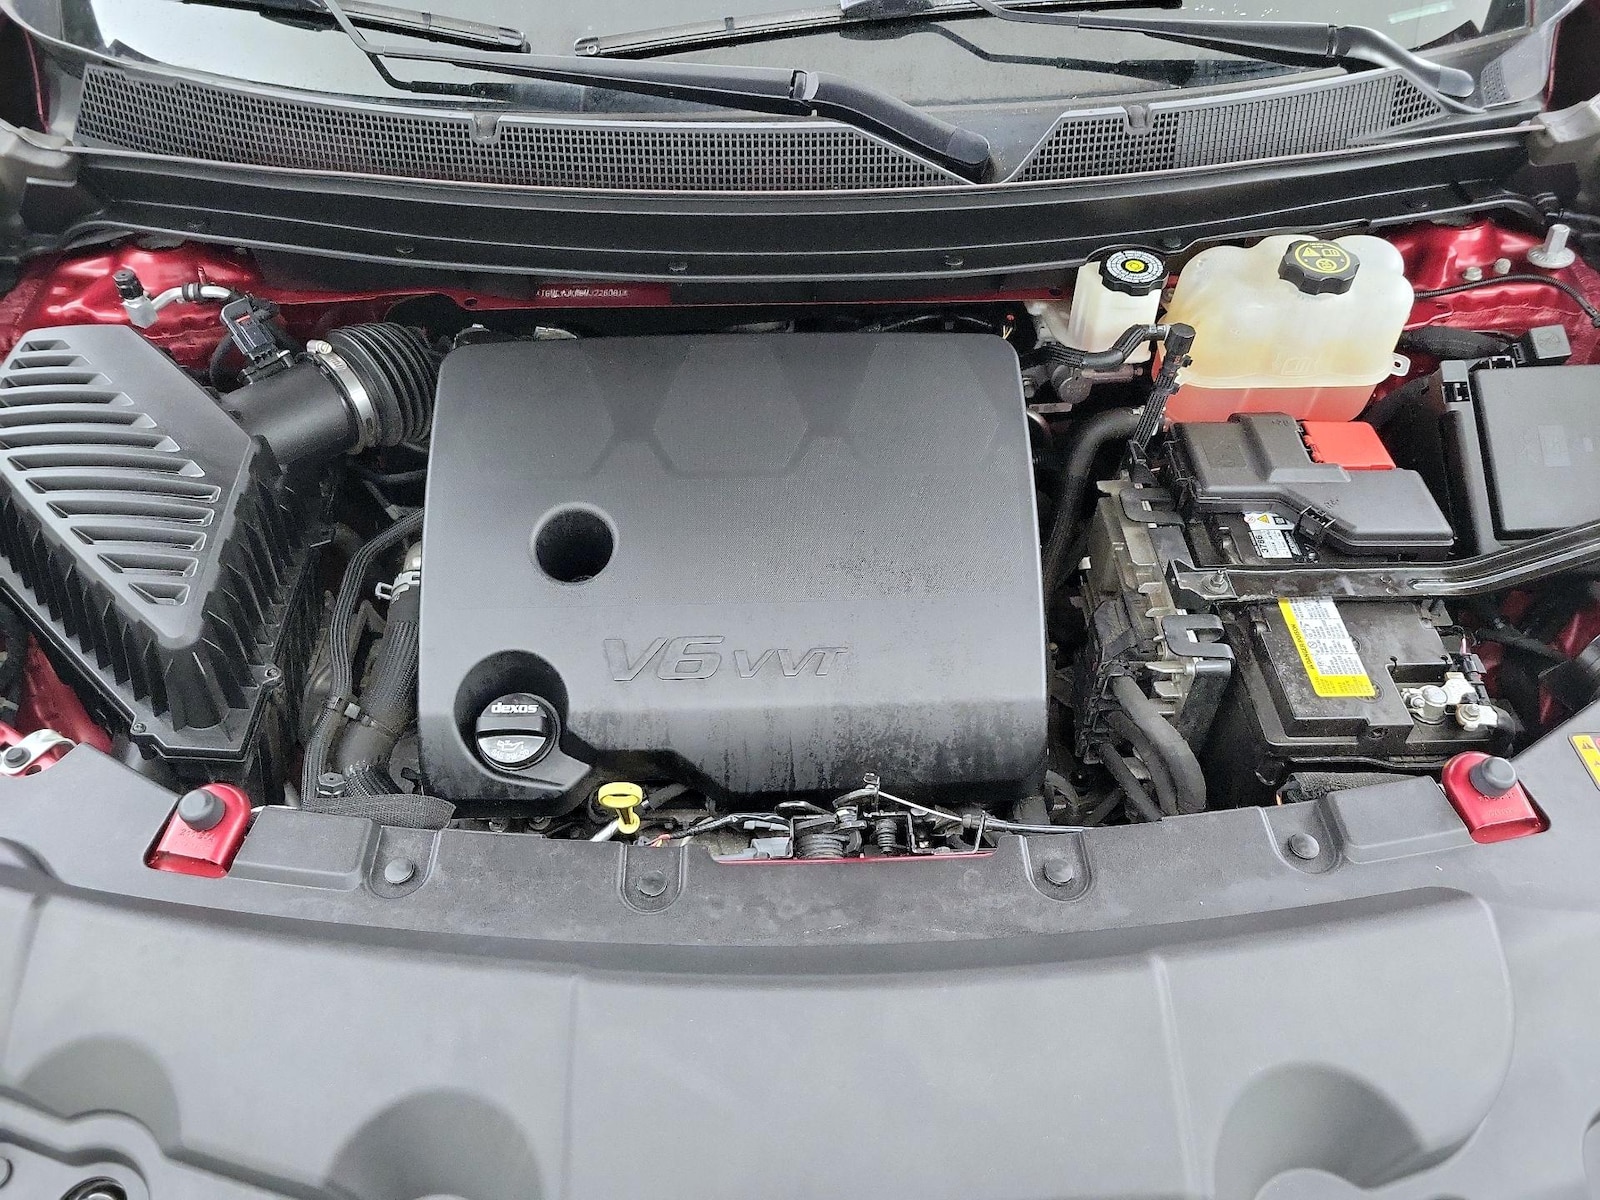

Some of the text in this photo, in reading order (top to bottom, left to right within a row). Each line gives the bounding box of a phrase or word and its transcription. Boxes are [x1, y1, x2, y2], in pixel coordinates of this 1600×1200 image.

[603, 635, 849, 682] V6 VVT
[1291, 623, 1313, 665] DANGER POISON
[491, 702, 539, 714] dexos
